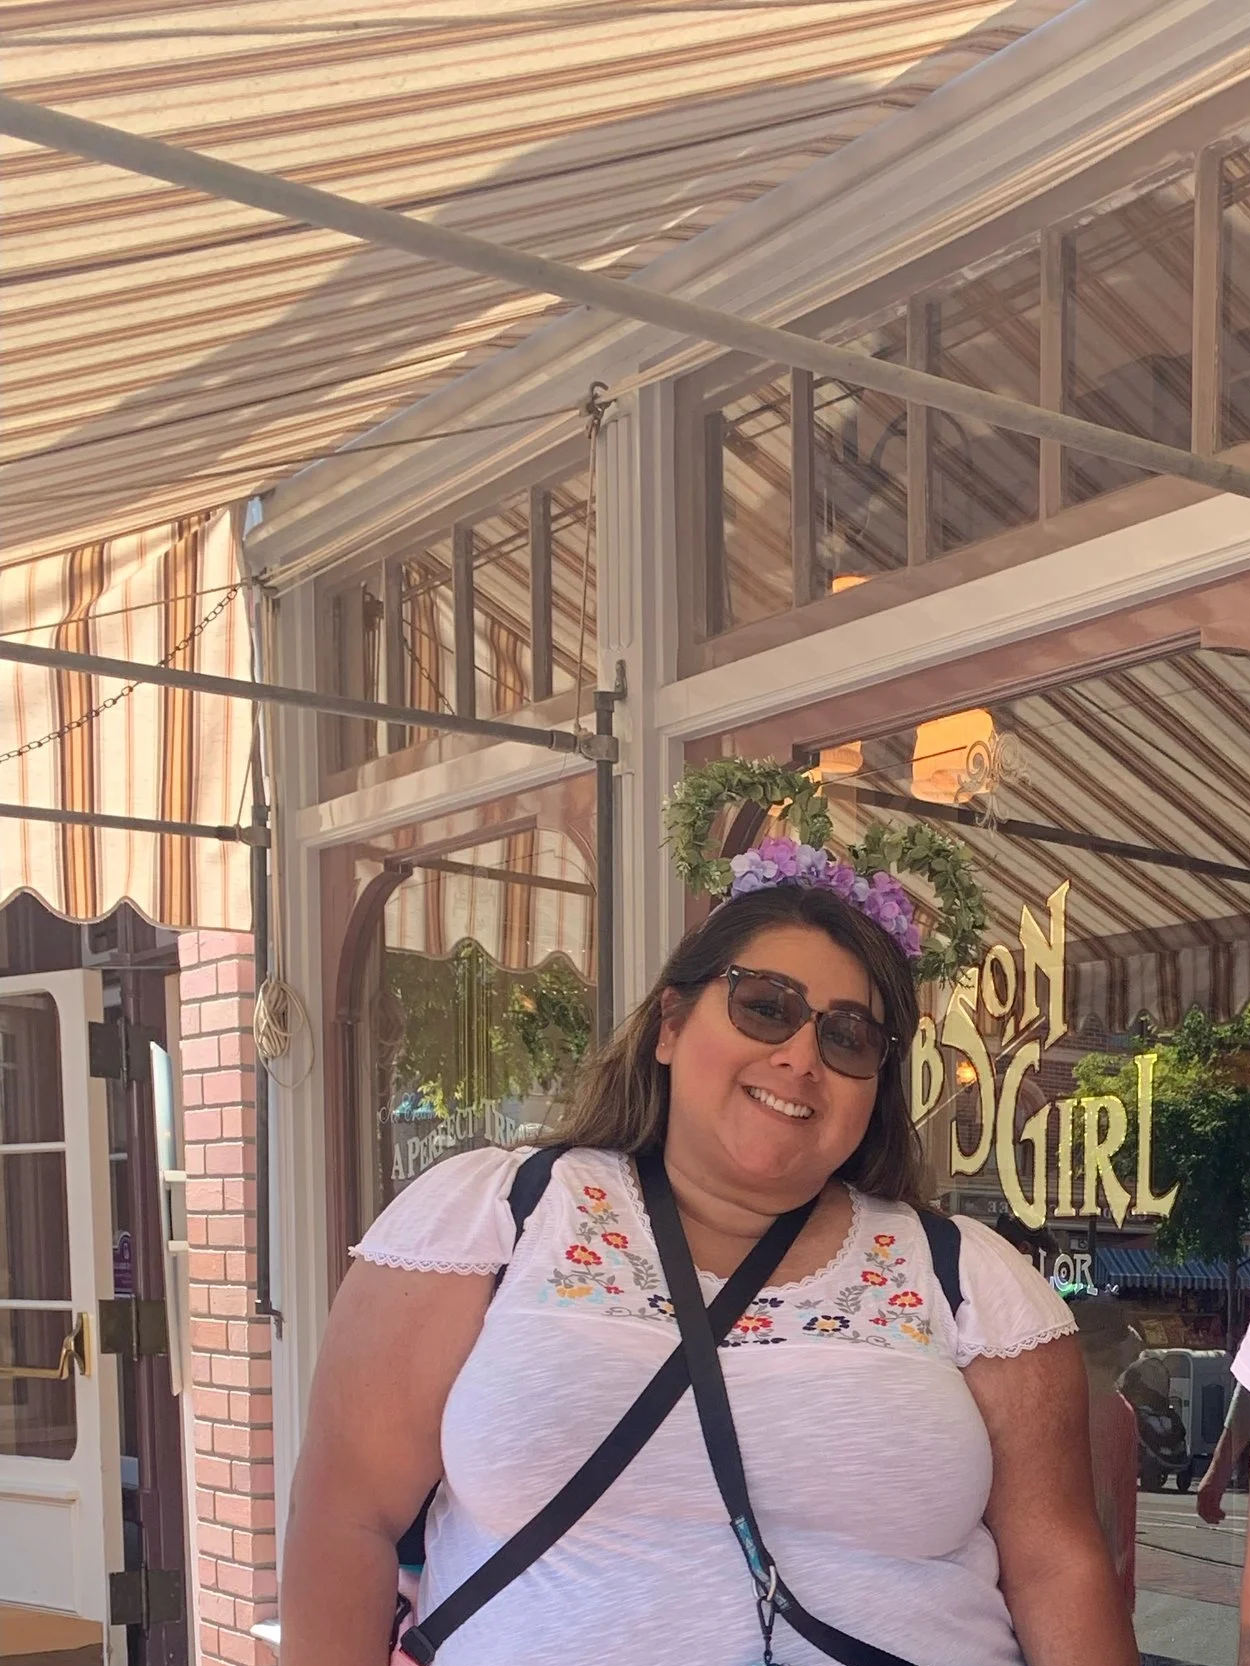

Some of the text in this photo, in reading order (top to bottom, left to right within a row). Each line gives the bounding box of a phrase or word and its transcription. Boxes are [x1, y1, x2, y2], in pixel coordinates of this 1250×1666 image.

[911, 880, 1070, 1176] BSON
[391, 1143, 406, 1180] A
[997, 1039, 1180, 1230] GIRL
